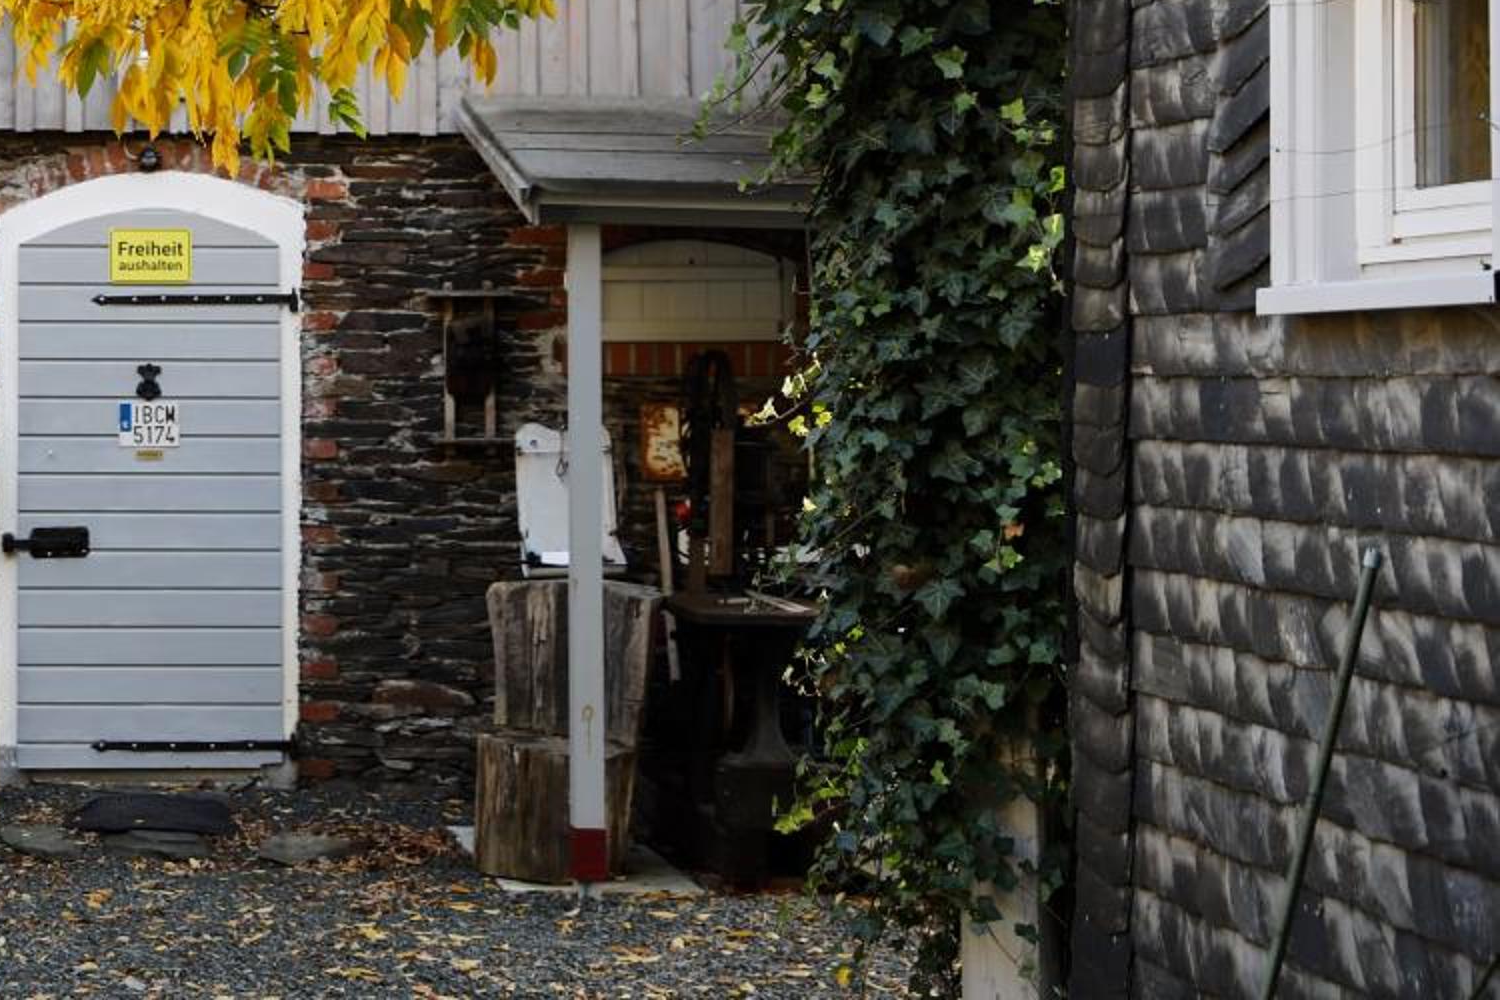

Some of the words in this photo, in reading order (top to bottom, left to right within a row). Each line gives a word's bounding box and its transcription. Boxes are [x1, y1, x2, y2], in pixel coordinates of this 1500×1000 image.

[117, 240, 184, 257] Freiheit
[118, 259, 183, 271] aushalten
[133, 425, 175, 443] 5174
